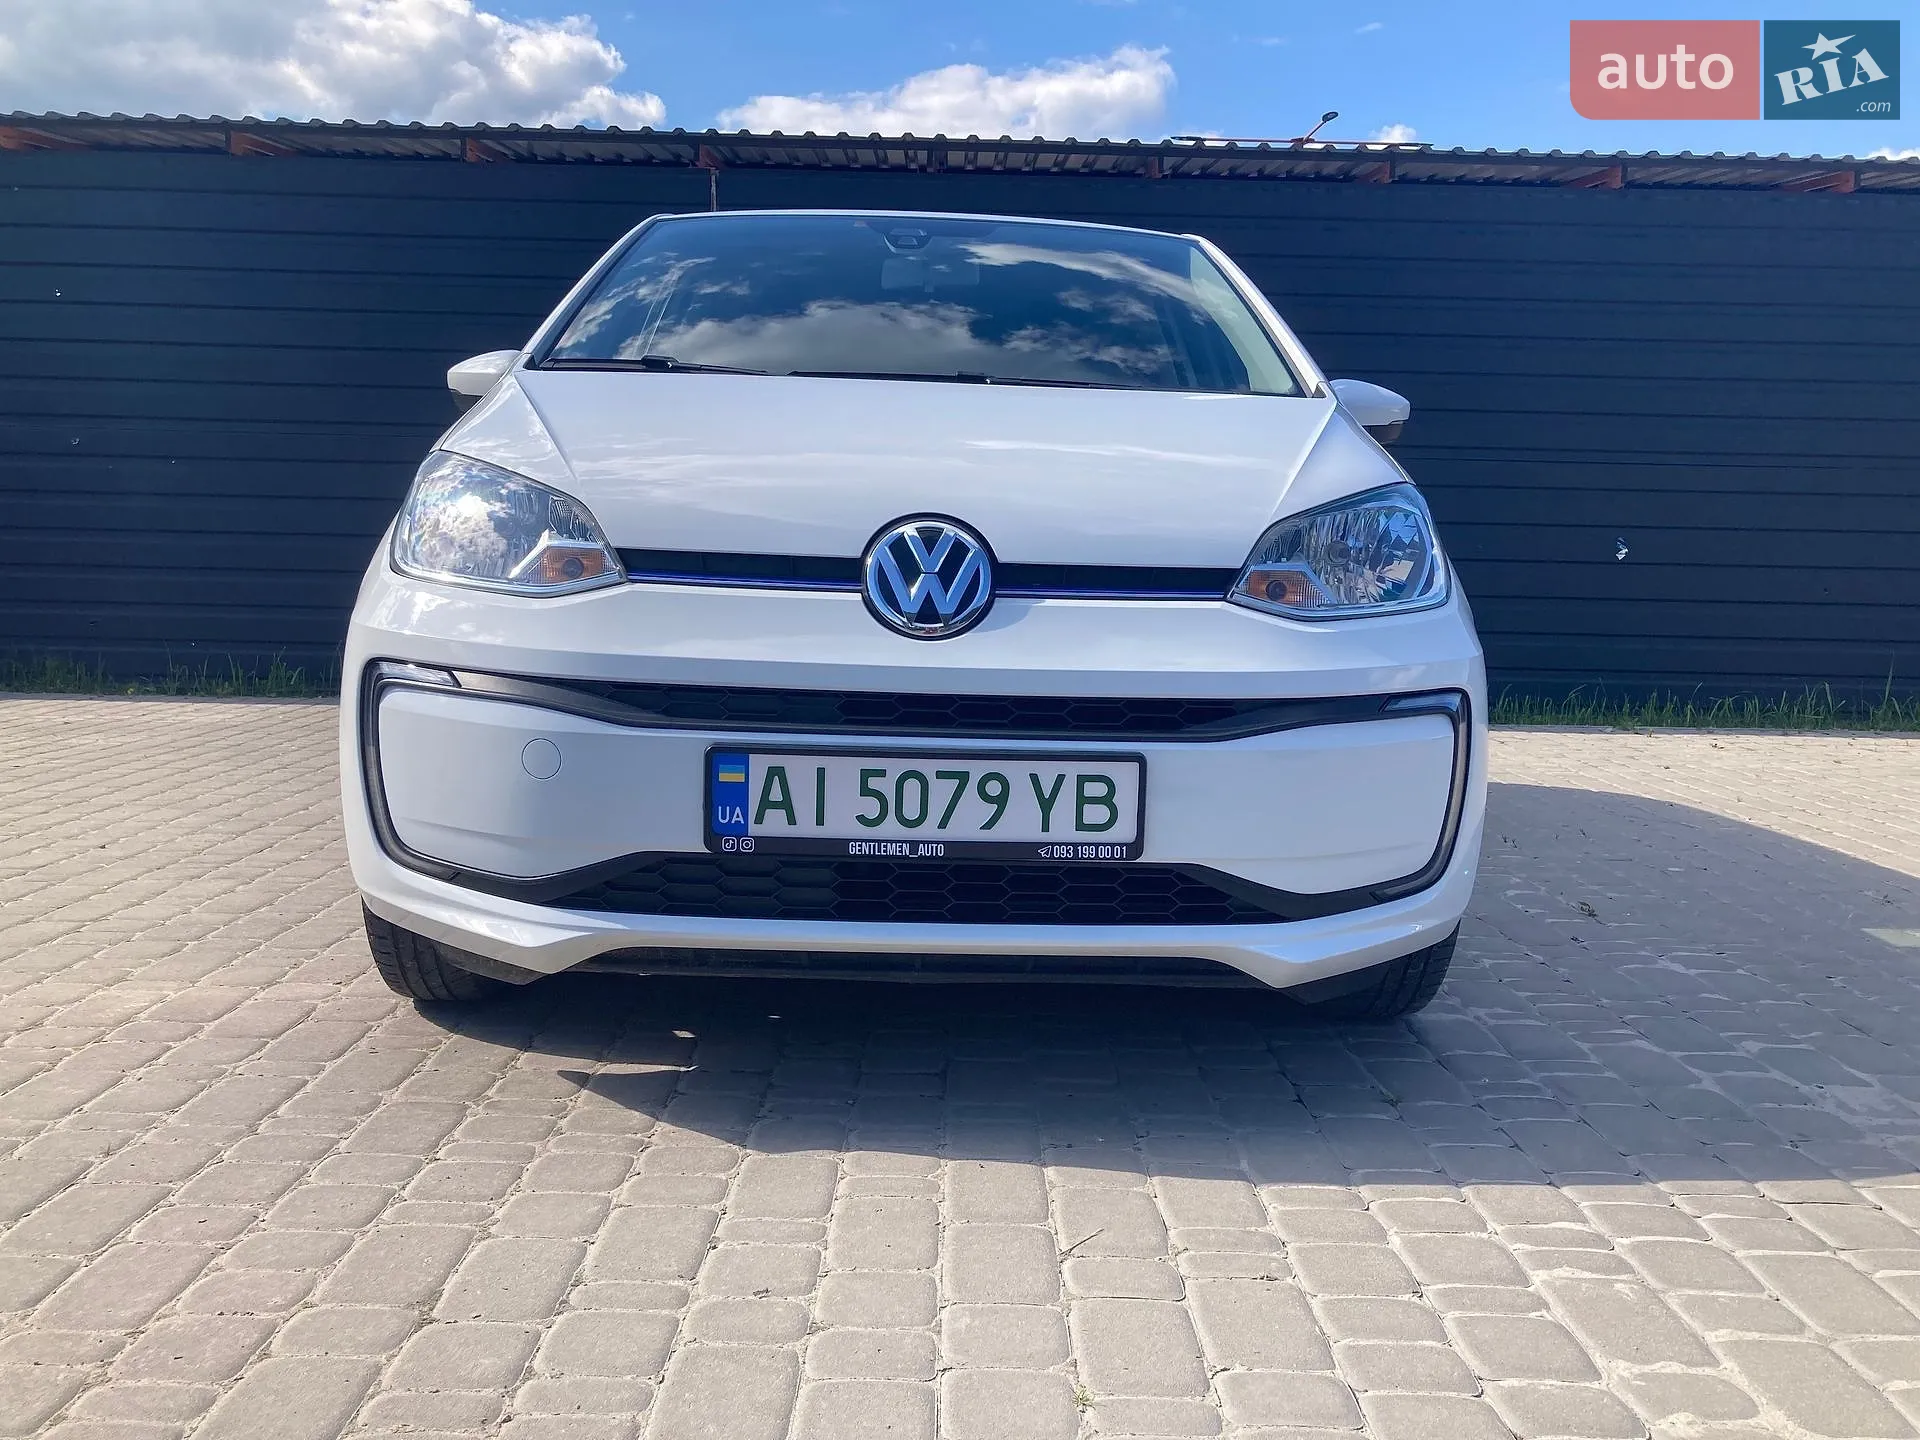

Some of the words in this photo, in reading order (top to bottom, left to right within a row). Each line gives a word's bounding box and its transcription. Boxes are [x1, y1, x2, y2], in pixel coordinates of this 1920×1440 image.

[855, 768, 1011, 831] 5079
[1028, 772, 1119, 833] YB
[718, 805, 745, 825] UA
[848, 841, 945, 858] GENTLEMEN_AUTO
[1053, 845, 1074, 859] 093
[1077, 845, 1096, 859] 199
[1098, 845, 1112, 859] 00
[1113, 845, 1127, 859] 01
